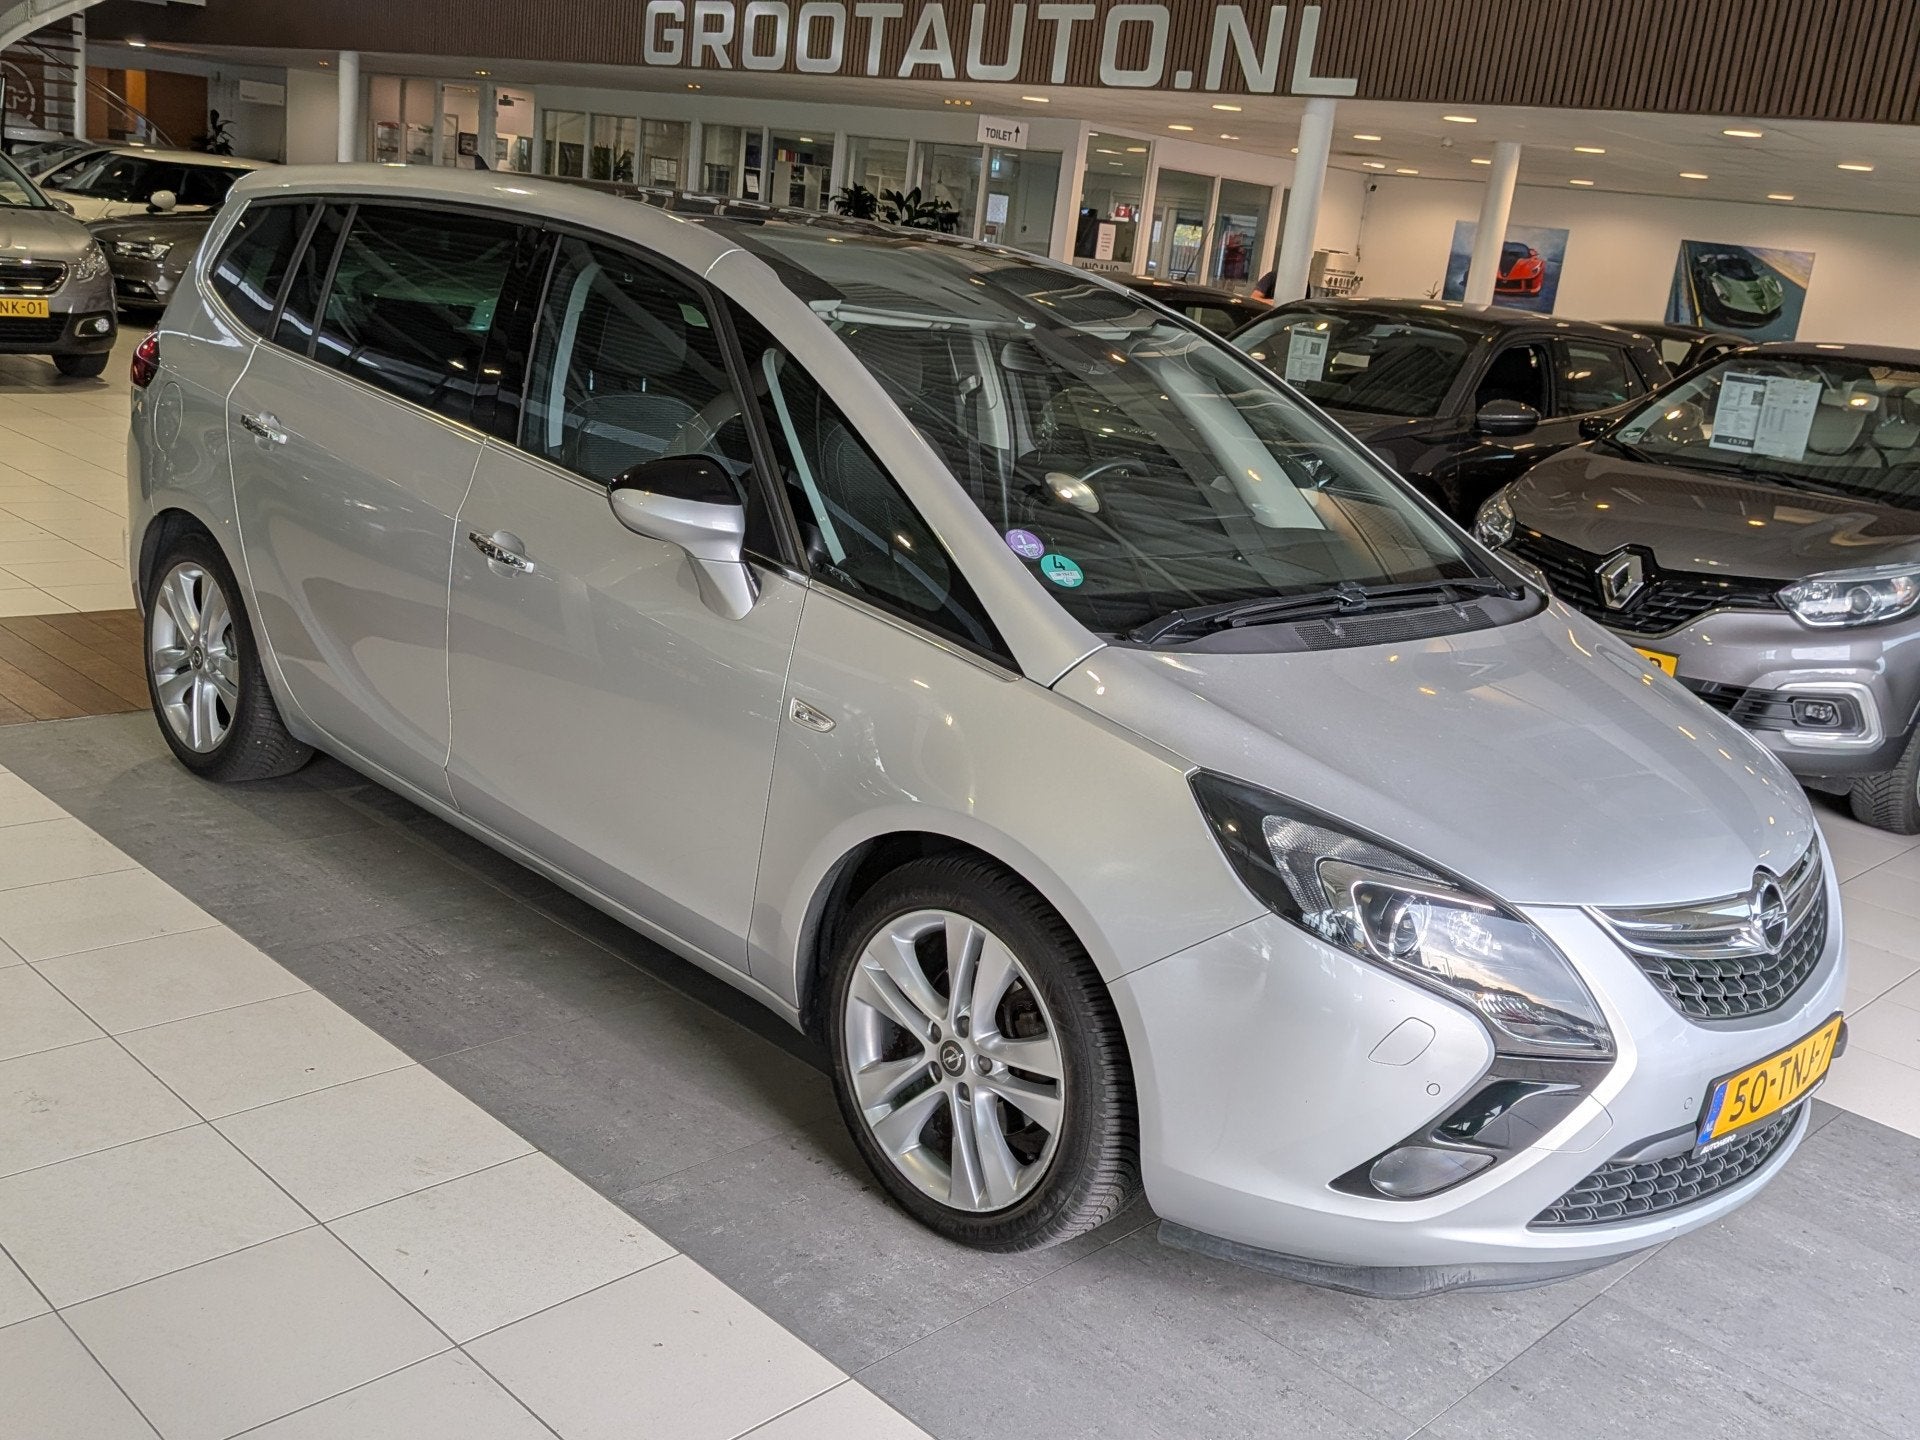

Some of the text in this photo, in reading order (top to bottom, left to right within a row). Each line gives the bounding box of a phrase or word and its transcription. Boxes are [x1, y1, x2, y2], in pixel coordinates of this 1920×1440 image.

[643, 0, 1358, 96] GROOTAUTO.NL
[985, 126, 1012, 142] TOILET
[0, 301, 42, 315] NK-01
[1728, 1029, 1833, 1123] 50-TNJ-7
